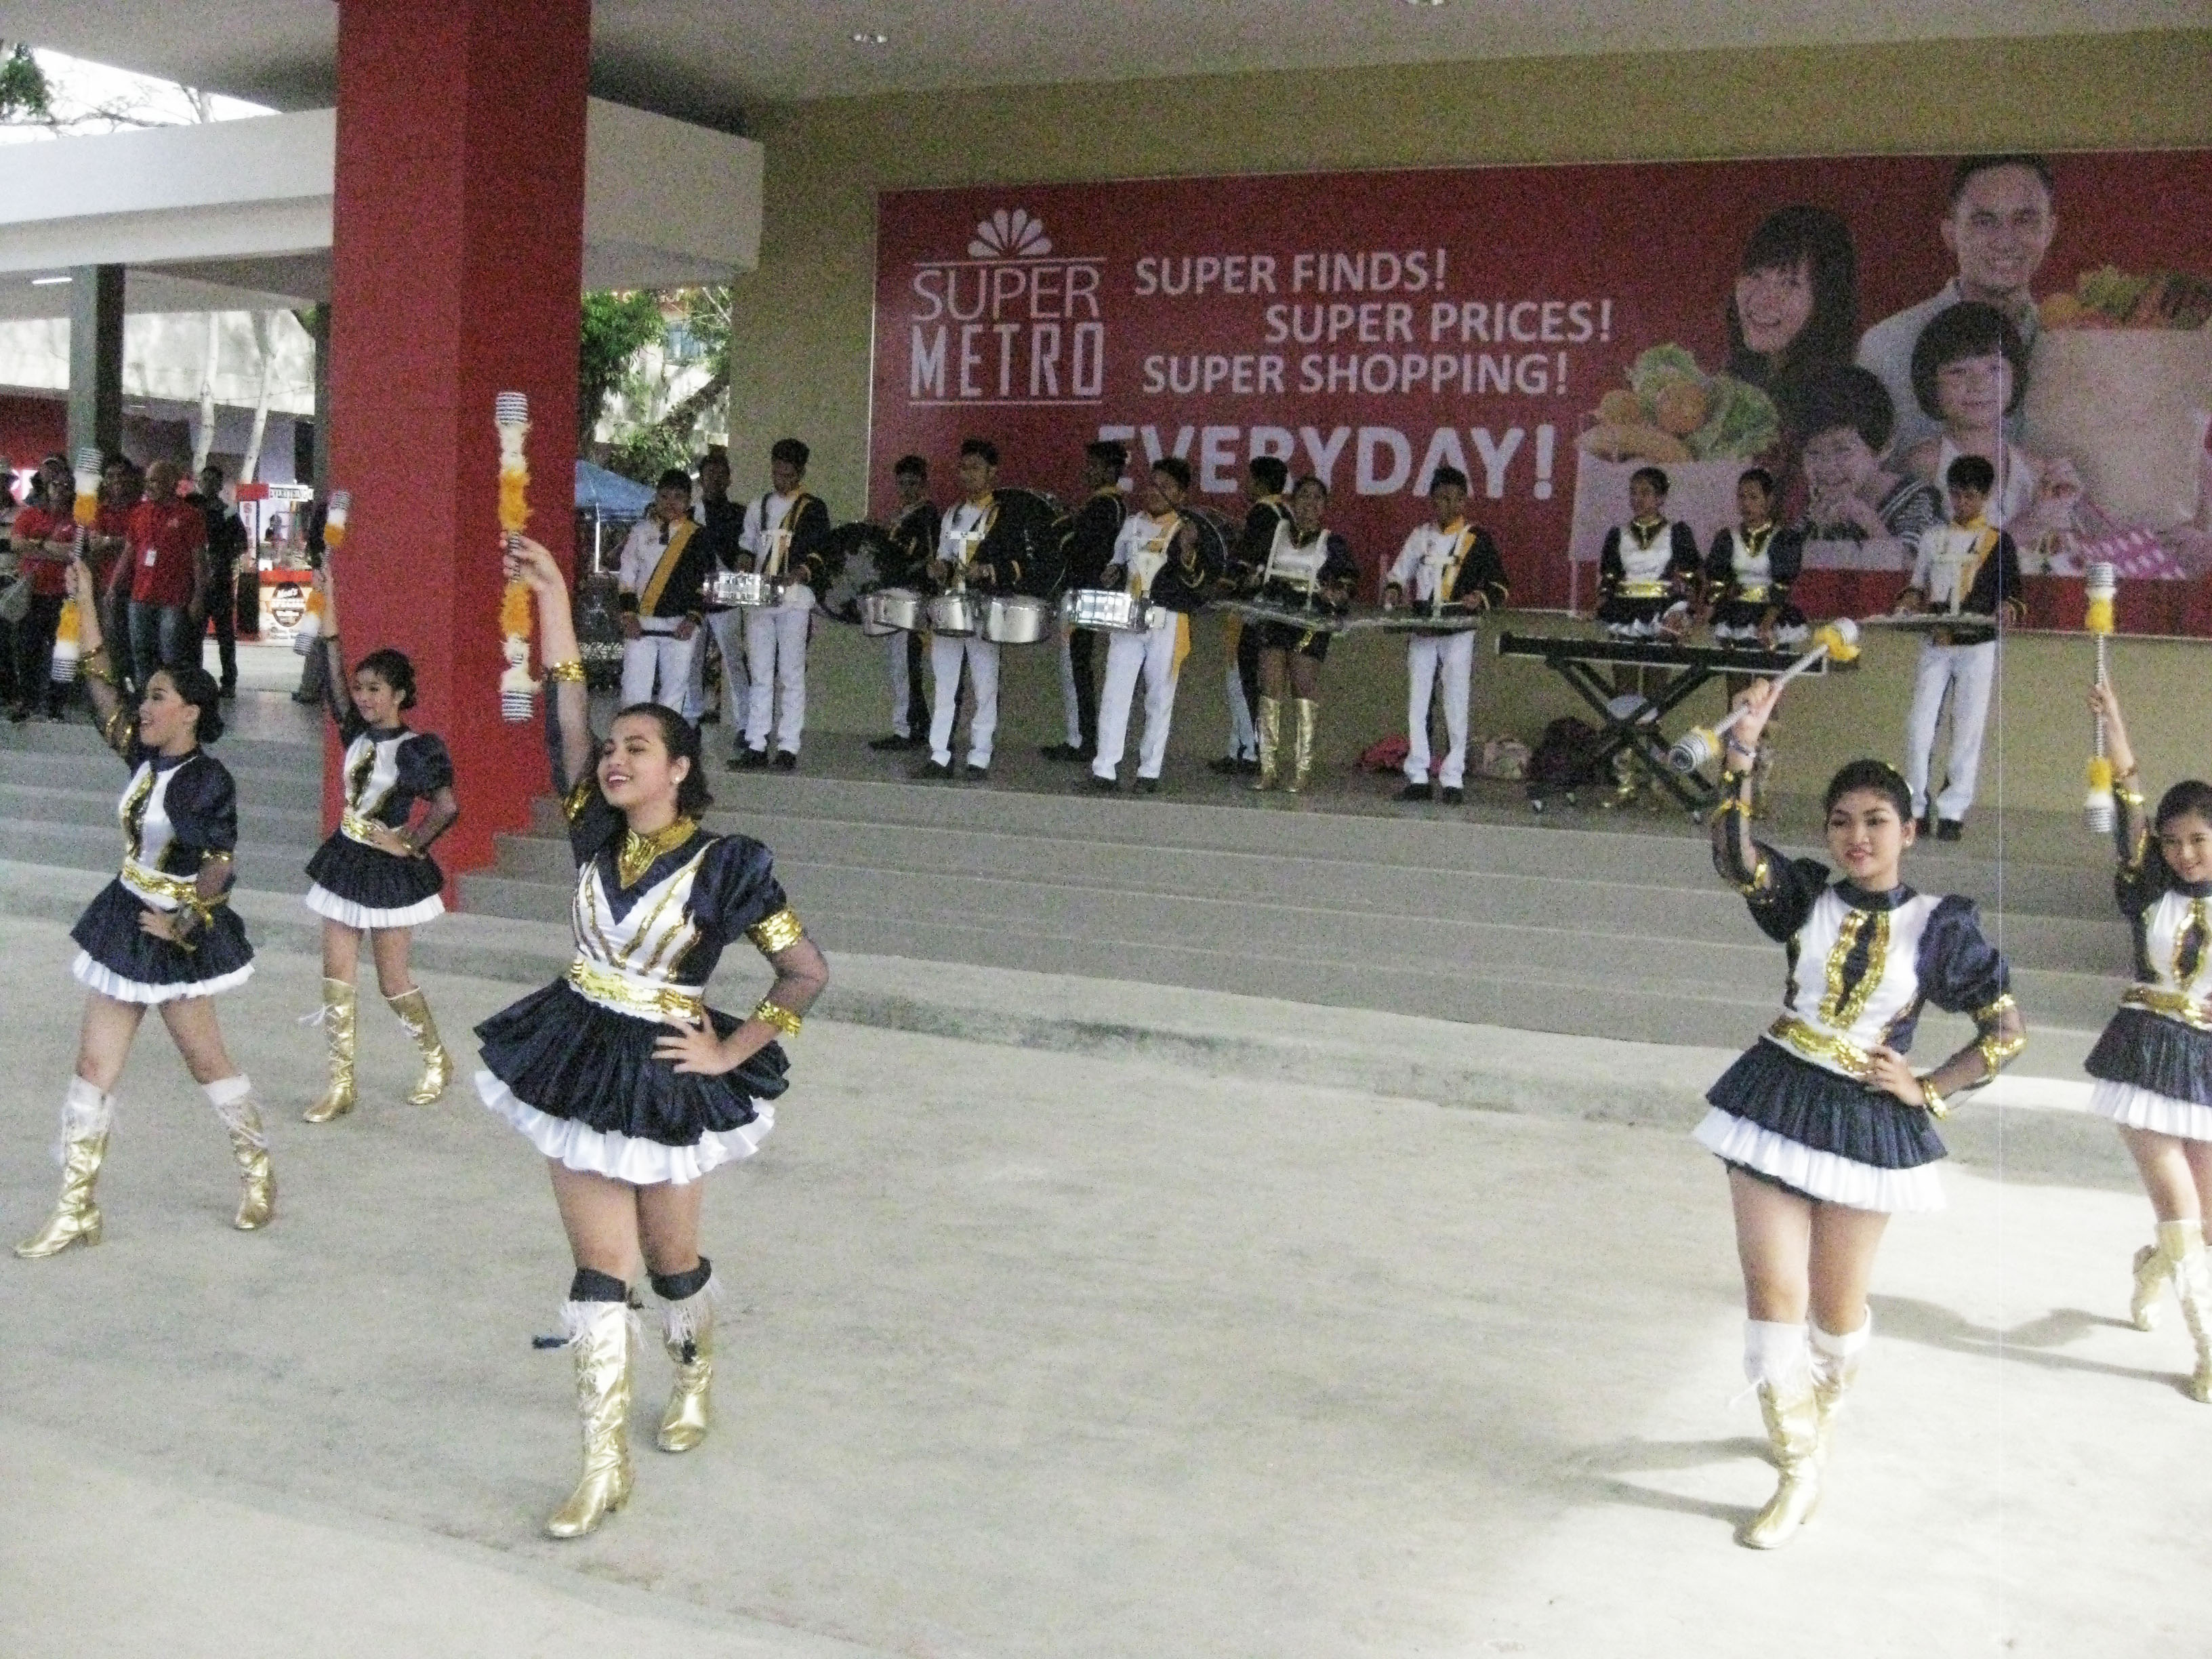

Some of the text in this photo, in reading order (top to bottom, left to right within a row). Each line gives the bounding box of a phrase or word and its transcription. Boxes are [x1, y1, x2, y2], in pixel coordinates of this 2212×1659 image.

[913, 265, 1101, 321] SUPER
[1134, 249, 1446, 295] SUPER FINDS!
[1265, 299, 1613, 344] SUPER PRICES!
[910, 323, 1105, 397] METRO
[1143, 352, 1568, 394] SUPER SHOPPING!
